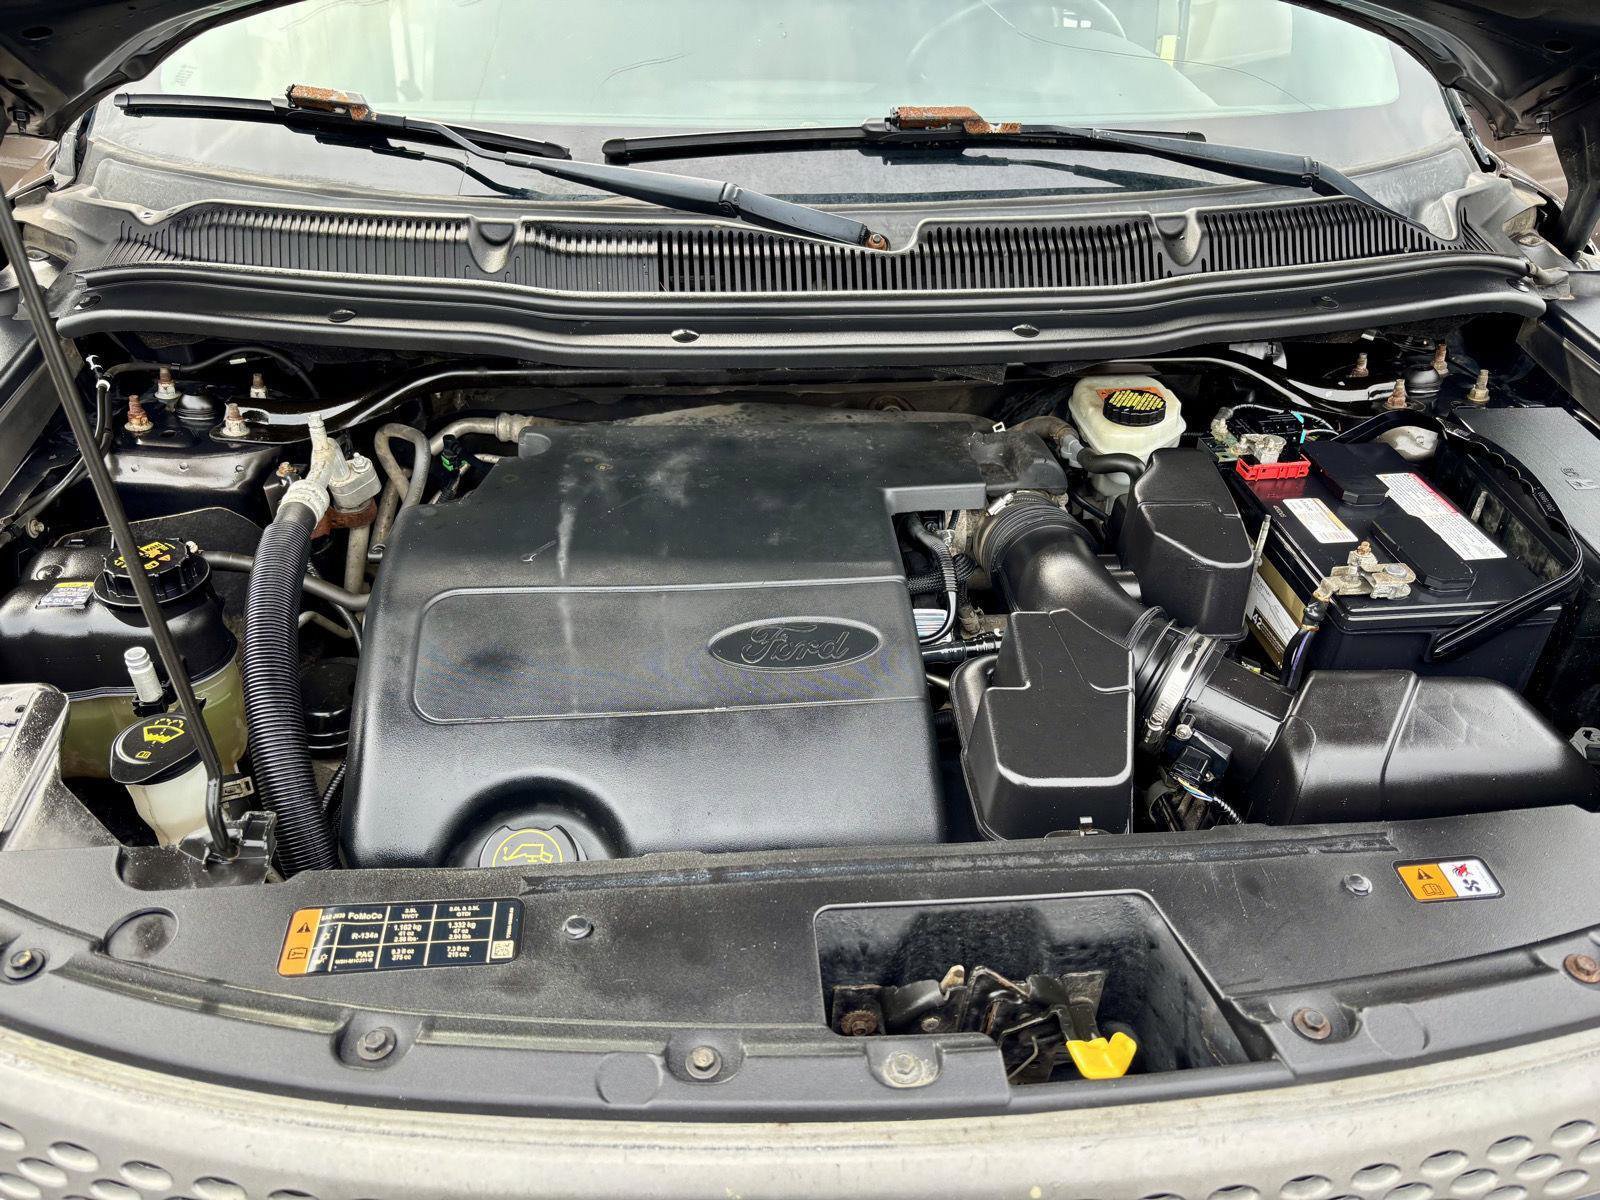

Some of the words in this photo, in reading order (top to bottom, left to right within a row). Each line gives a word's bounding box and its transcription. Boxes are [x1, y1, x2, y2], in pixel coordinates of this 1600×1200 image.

[741, 624, 850, 664] Ford
[348, 912, 383, 920] FoMoCo
[412, 923, 422, 932] kg
[466, 921, 477, 929] kg
[351, 932, 379, 940] R-134a
[356, 950, 375, 959] PAG
